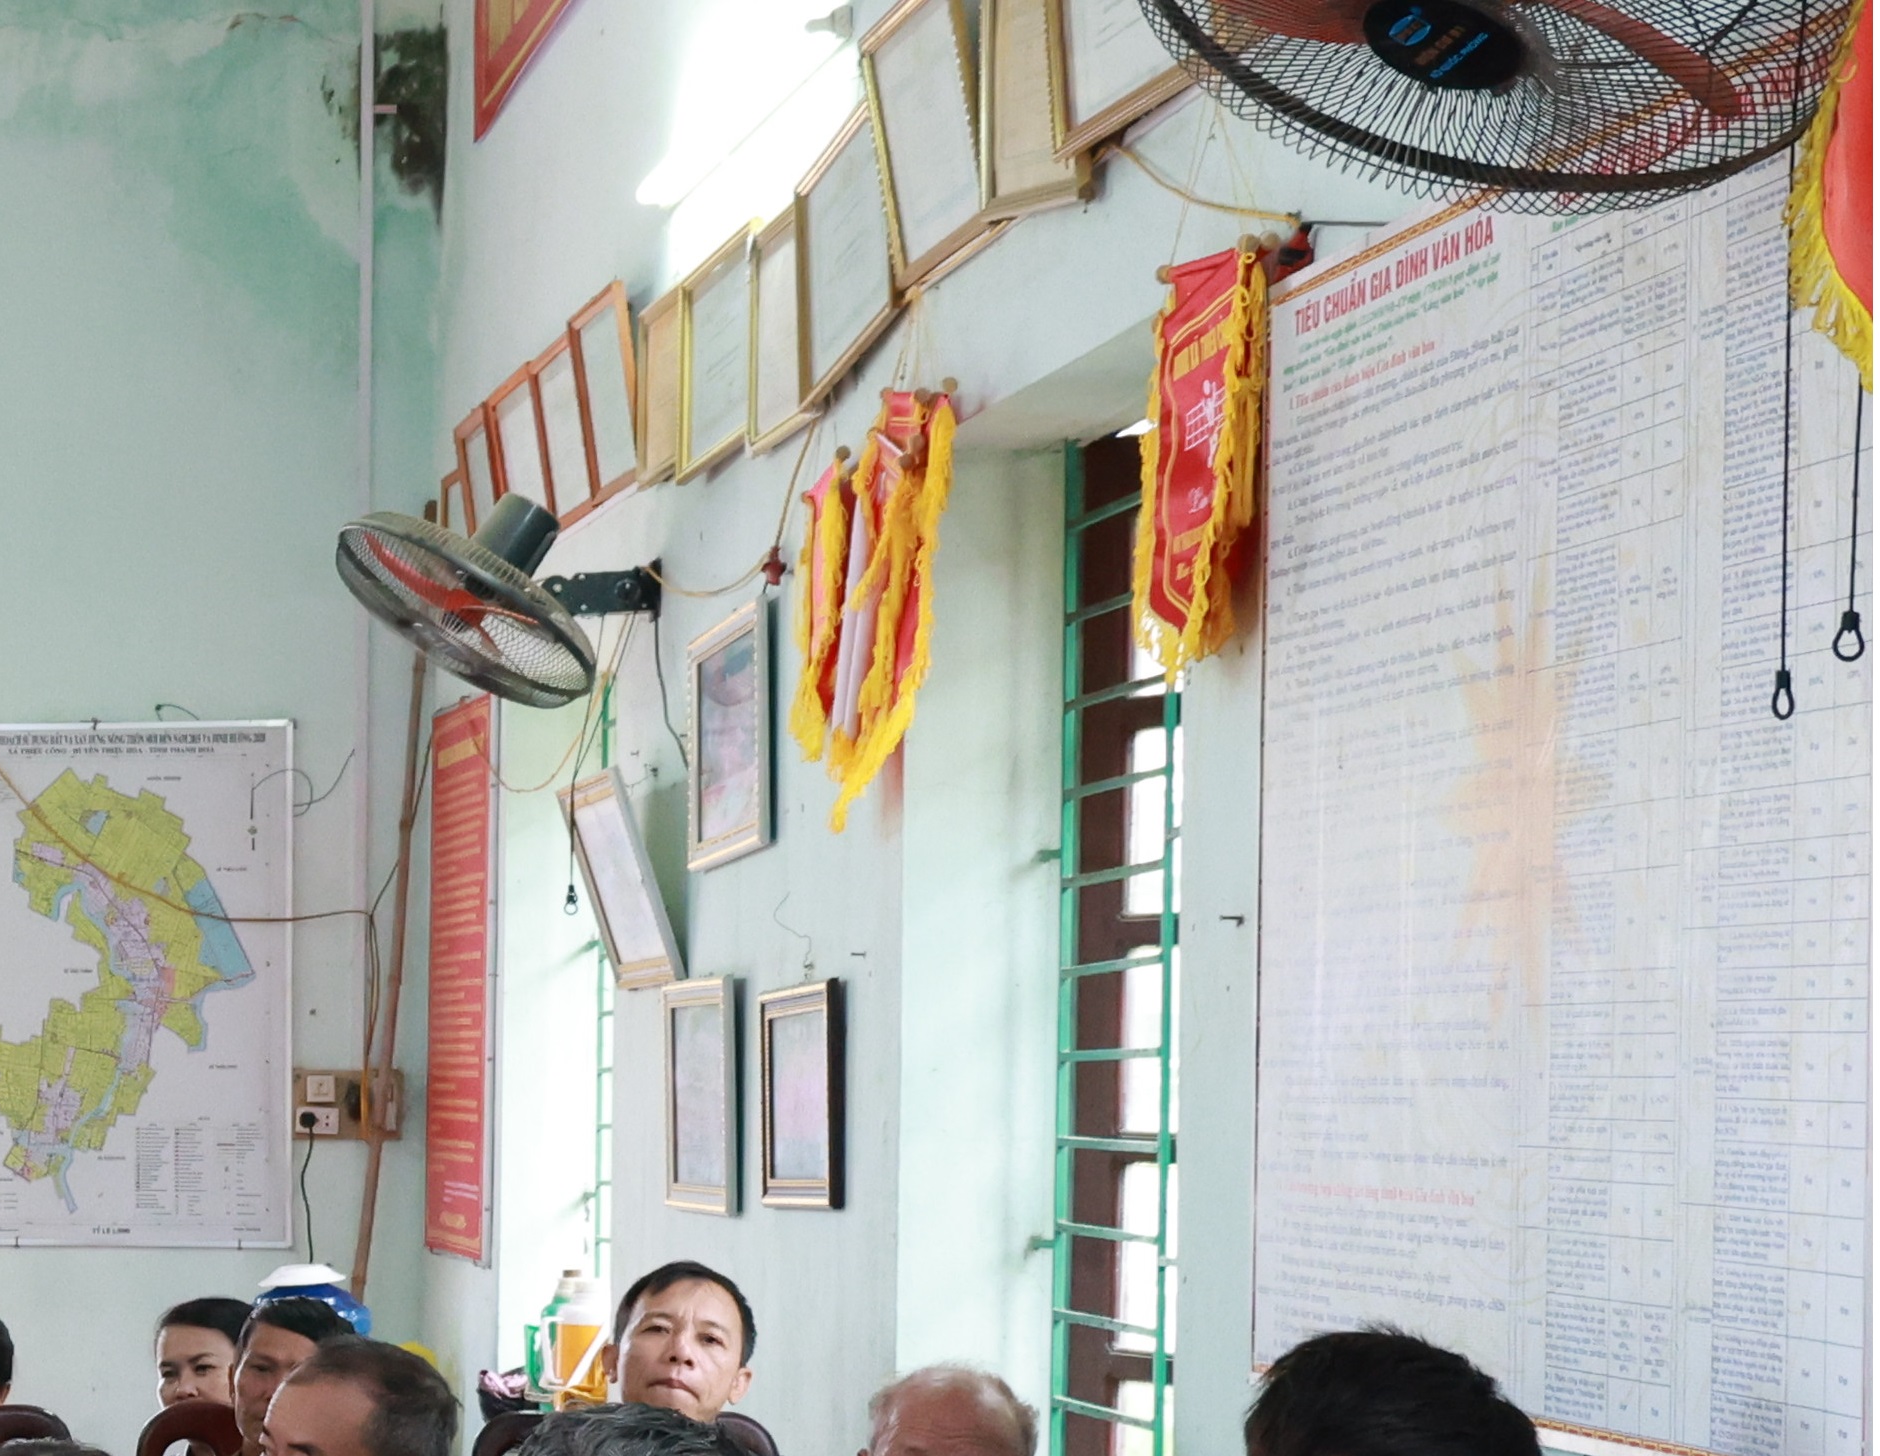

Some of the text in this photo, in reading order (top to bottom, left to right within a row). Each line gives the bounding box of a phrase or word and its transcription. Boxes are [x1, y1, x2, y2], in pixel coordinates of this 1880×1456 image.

[1295, 213, 1494, 336] TIÊU CHUẨN GIA ĐÌNH VĂN HÓA
